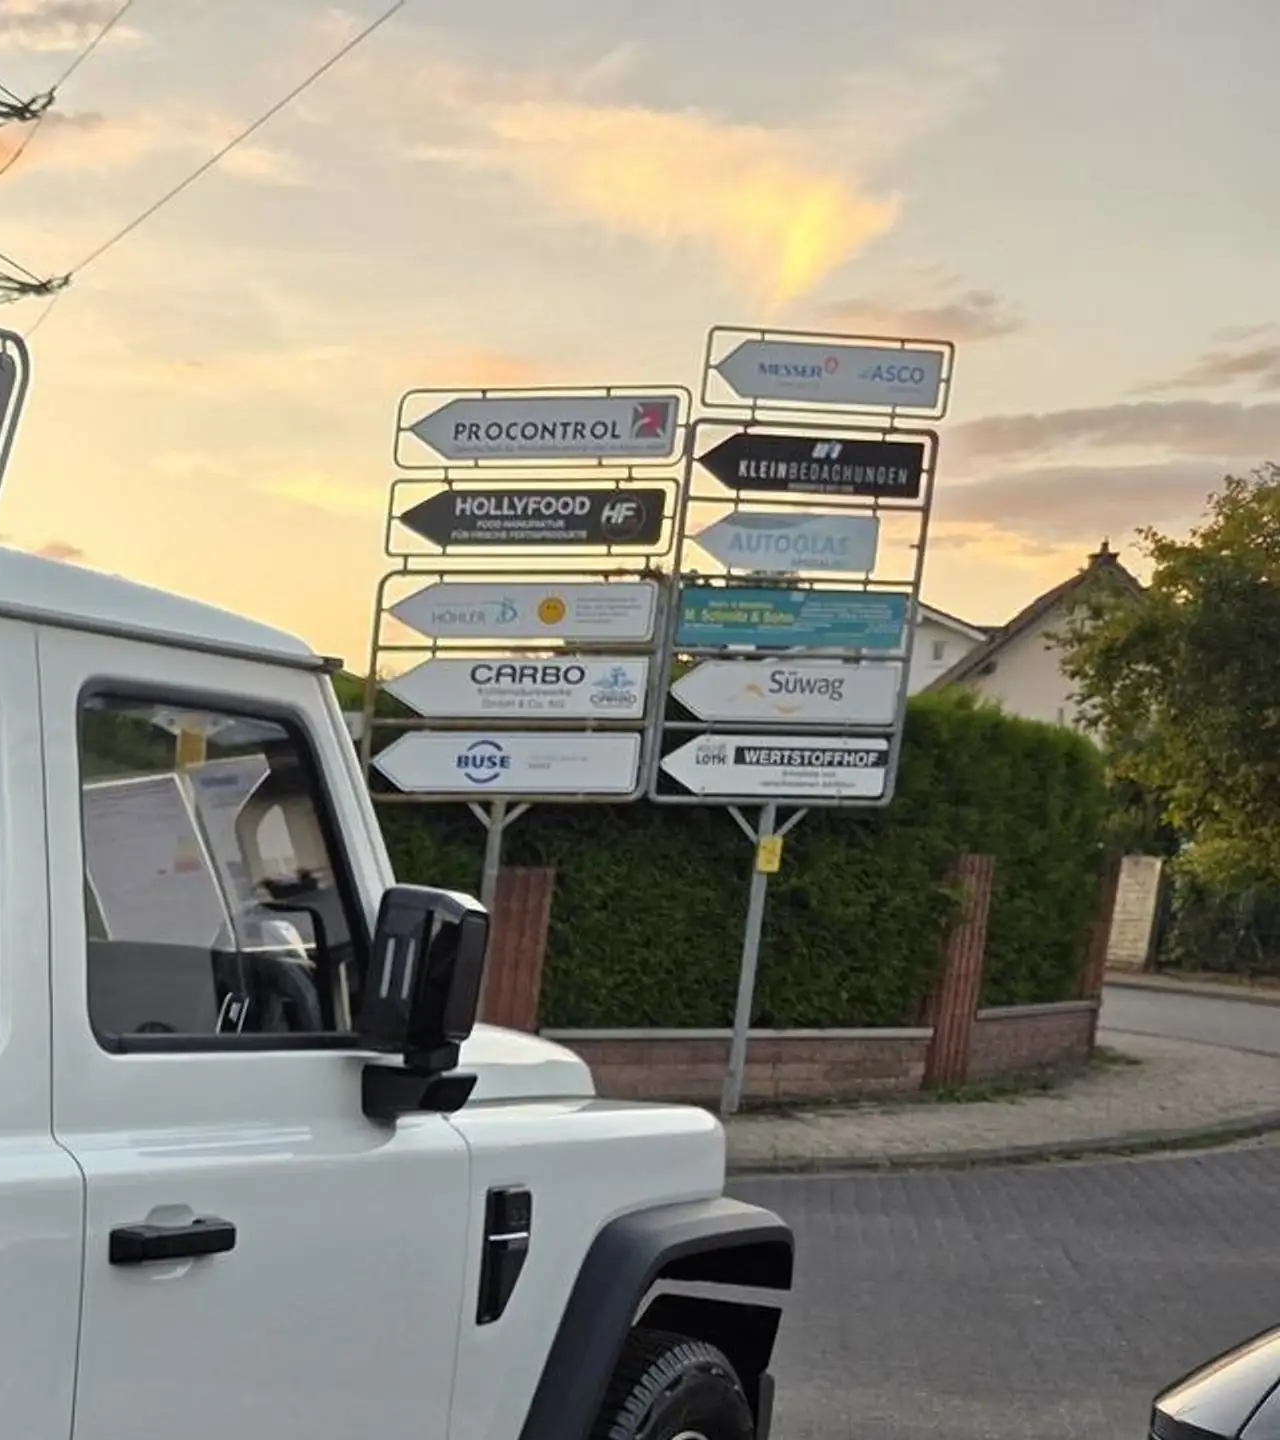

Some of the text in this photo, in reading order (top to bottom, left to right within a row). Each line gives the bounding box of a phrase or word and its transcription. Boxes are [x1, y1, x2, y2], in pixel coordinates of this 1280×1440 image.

[757, 361, 823, 379] MESSER
[870, 364, 925, 384] ASCO
[452, 421, 622, 441] PROCONTROL
[454, 496, 590, 516] HOLLYFOOD
[600, 501, 637, 525] HF
[470, 663, 586, 685] CARBO
[768, 670, 844, 701] Süwag
[456, 754, 511, 770] BUSE
[743, 749, 880, 767] WERTSTOFFHOF
